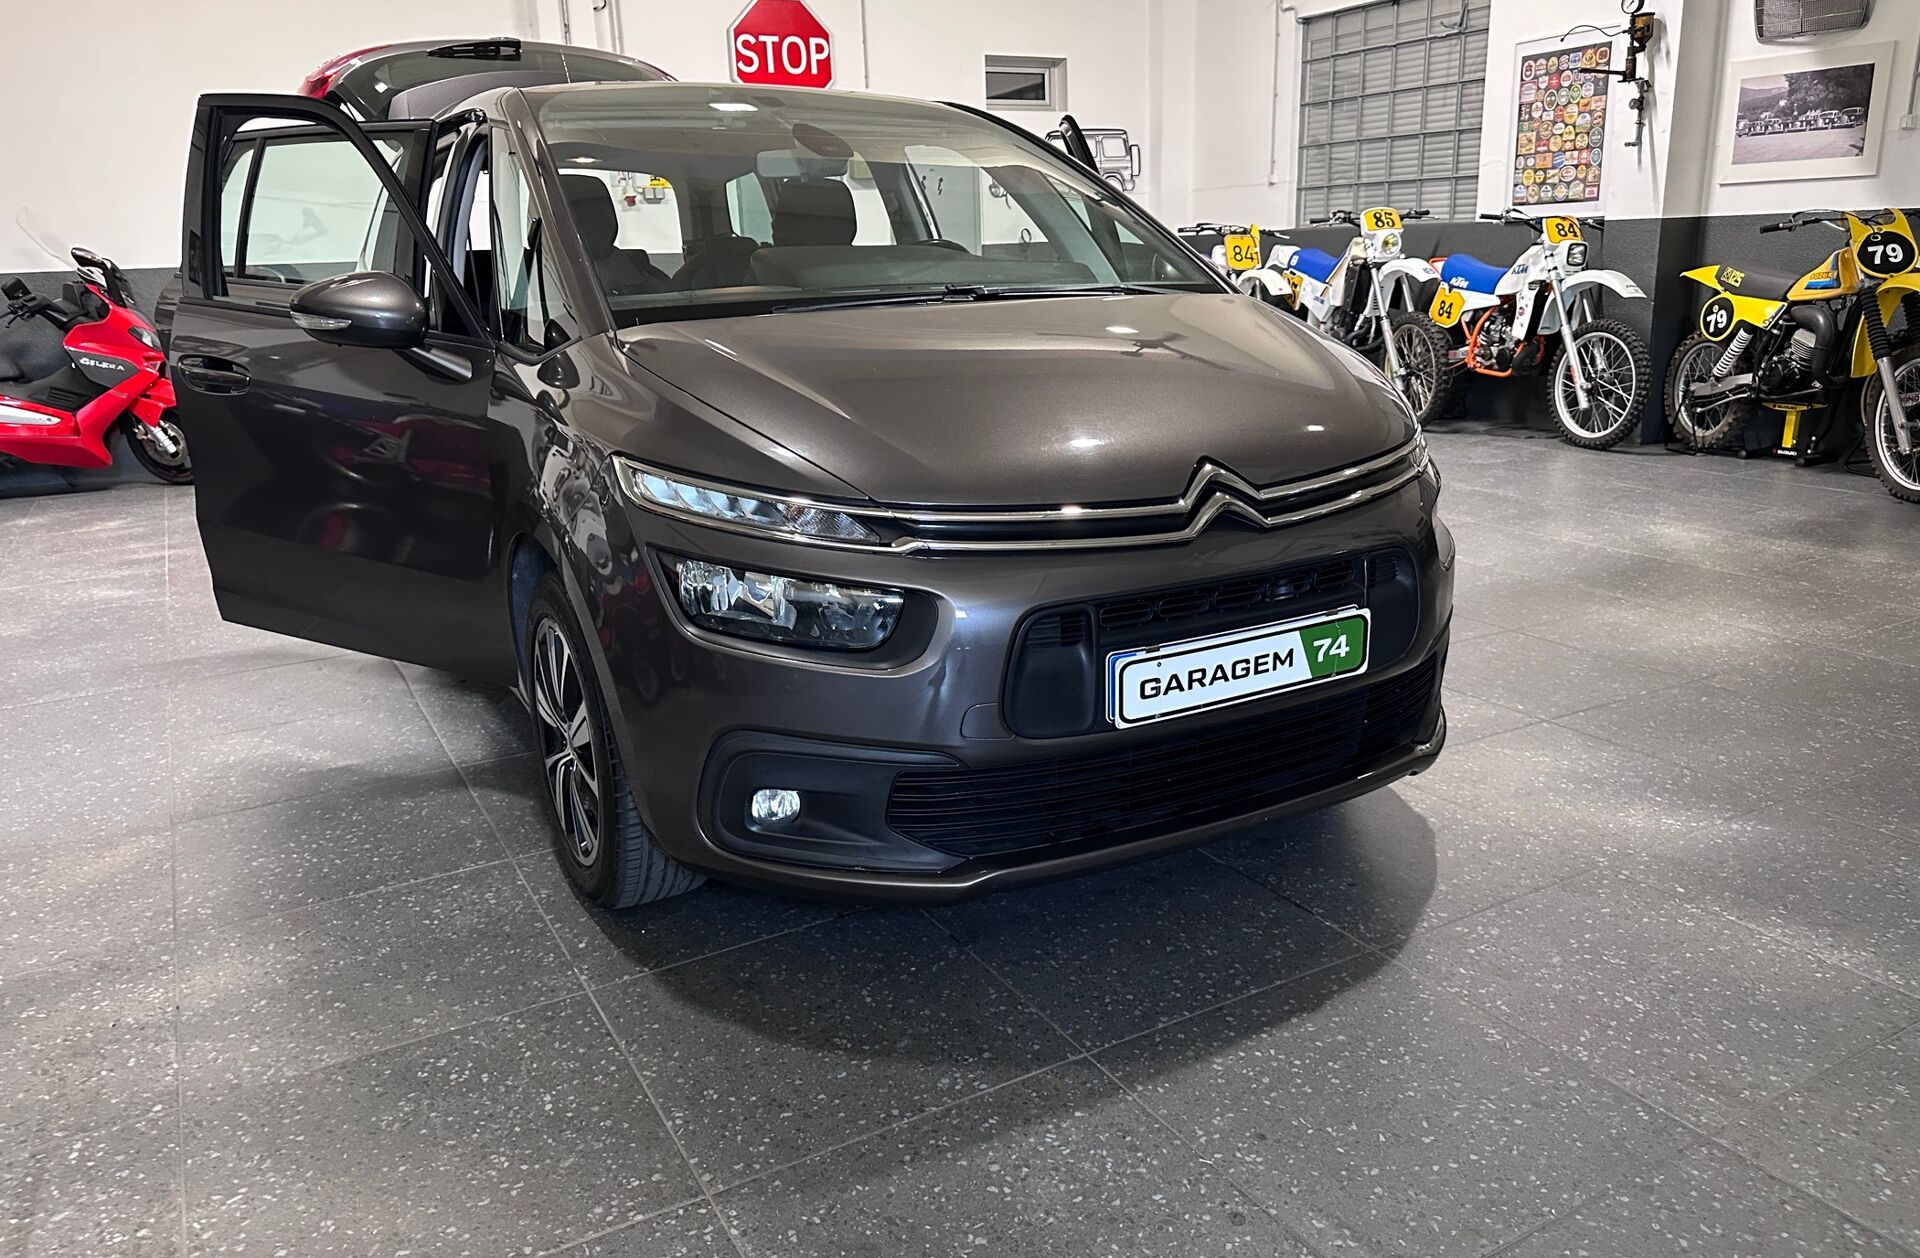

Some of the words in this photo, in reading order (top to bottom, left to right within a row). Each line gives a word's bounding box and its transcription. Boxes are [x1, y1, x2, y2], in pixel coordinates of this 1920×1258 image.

[736, 34, 830, 75] STOP
[1373, 212, 1396, 228] 85
[1555, 222, 1579, 238] 84
[1867, 243, 1904, 265] 79
[1511, 263, 1529, 275] KTM
[1449, 276, 1469, 288] KTM
[1437, 300, 1453, 319] 84
[1706, 309, 1727, 333] 79
[79, 357, 125, 371] GILERA
[1139, 648, 1295, 700] GARAGEM
[1312, 634, 1350, 663] 74
